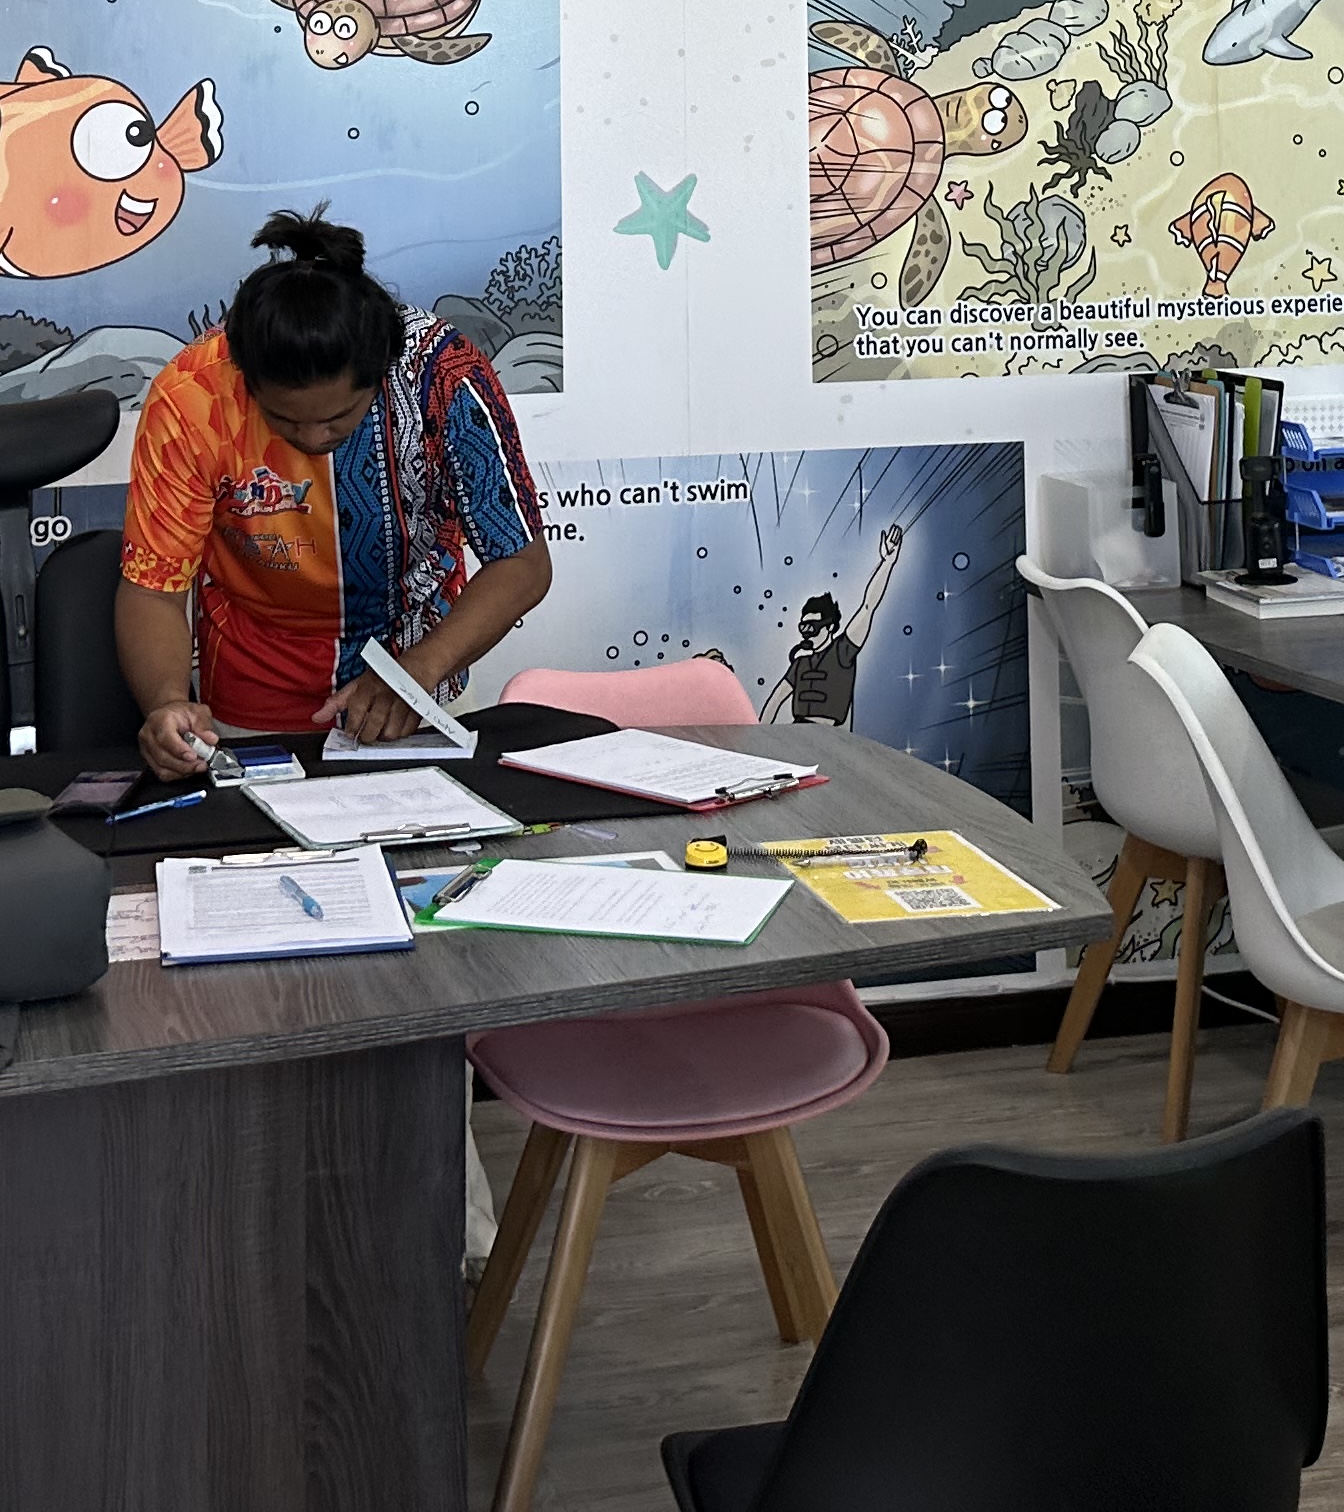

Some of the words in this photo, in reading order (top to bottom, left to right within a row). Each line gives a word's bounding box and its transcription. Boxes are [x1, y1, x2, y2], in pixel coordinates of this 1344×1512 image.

[856, 306, 896, 327] You
[904, 307, 942, 325] can
[950, 303, 1034, 325] discover
[1040, 306, 1052, 321] a
[1059, 296, 1150, 321] beautiful
[1157, 295, 1265, 321] mysterious
[856, 334, 900, 356] that
[906, 338, 943, 358] you
[951, 331, 1004, 353] can't
[1010, 326, 1098, 352] normally
[1104, 332, 1145, 348] see.
[556, 483, 611, 508] who
[619, 480, 680, 505] can't
[686, 479, 748, 502] swim
[33, 519, 67, 543] go
